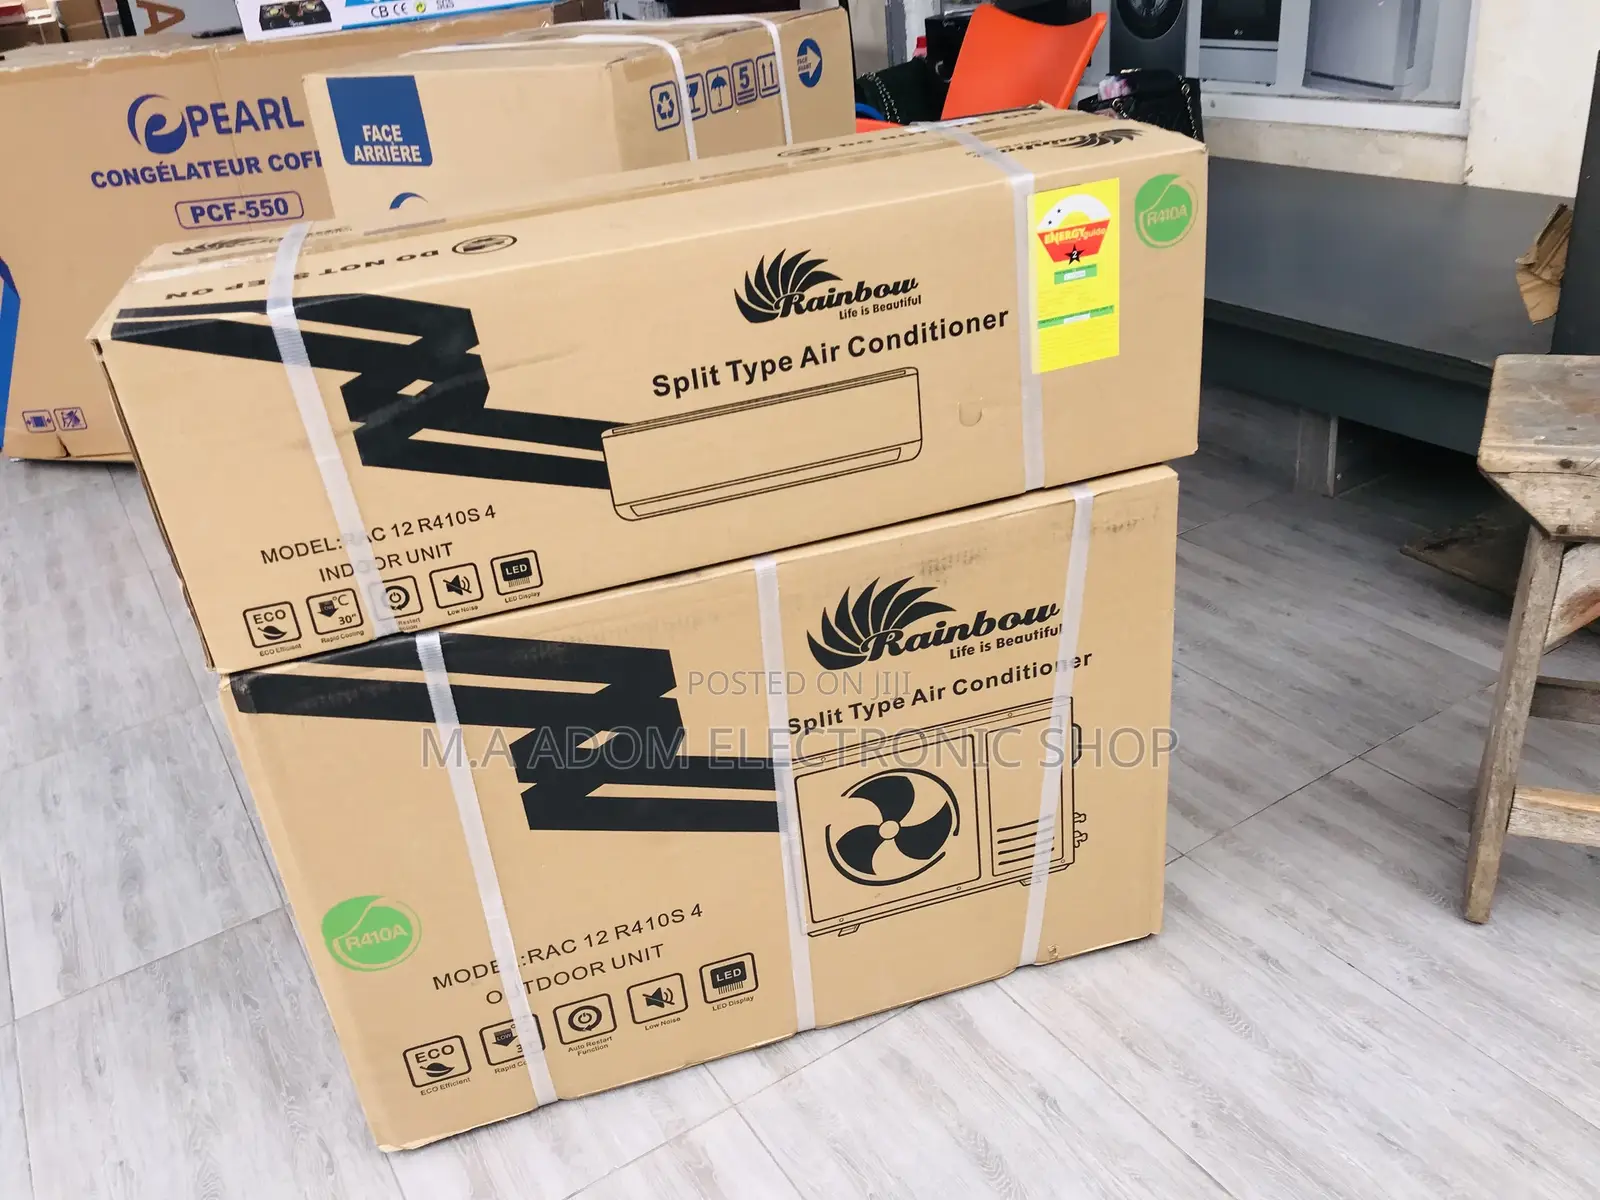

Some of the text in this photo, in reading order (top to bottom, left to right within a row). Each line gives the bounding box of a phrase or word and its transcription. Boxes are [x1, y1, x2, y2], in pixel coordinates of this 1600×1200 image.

[738, 66, 750, 89] 5
[185, 96, 305, 138] PEARL
[362, 124, 403, 142] FACE
[354, 141, 423, 162] ARRIÈRE
[91, 156, 263, 189] CONGÉLATEUR
[190, 197, 289, 224] PCF-550
[1147, 205, 1188, 226] R410A
[1044, 227, 1107, 245] ENERGY guide
[1071, 251, 1078, 259] 2
[165, 249, 440, 300] DO NOT SEP ON
[773, 277, 919, 318] Rainbow
[839, 294, 922, 320] Life is Beautiful
[652, 364, 721, 398] Split
[726, 354, 794, 385] Type
[800, 341, 840, 369] Air
[848, 308, 1009, 358] Conditioner
[391, 521, 414, 537] 12
[418, 507, 480, 533] R410S
[485, 504, 496, 518] 4
[406, 541, 453, 564] UNIT
[505, 563, 528, 576] LED
[504, 591, 541, 604] LED Display
[253, 609, 286, 624] ECO
[859, 601, 1061, 662] Rainbow
[949, 644, 975, 660] Life
[980, 640, 992, 653] is
[787, 652, 1092, 736] Split Type Air Conditioner
[584, 930, 609, 948] 12
[614, 909, 685, 940] R410S
[690, 903, 703, 918] 4
[345, 924, 409, 951] R410A
[486, 943, 664, 1004] OTDOOR UNIT
[716, 967, 742, 983] LED
[712, 995, 755, 1011] LED Display
[645, 1017, 681, 1031] Low Noise
[415, 1045, 455, 1064] ECO
[568, 1036, 613, 1053] Auto Restart
[577, 1043, 609, 1056] Function
[494, 1063, 516, 1074] Rapid
[420, 1077, 471, 1096] ECO Efficient
